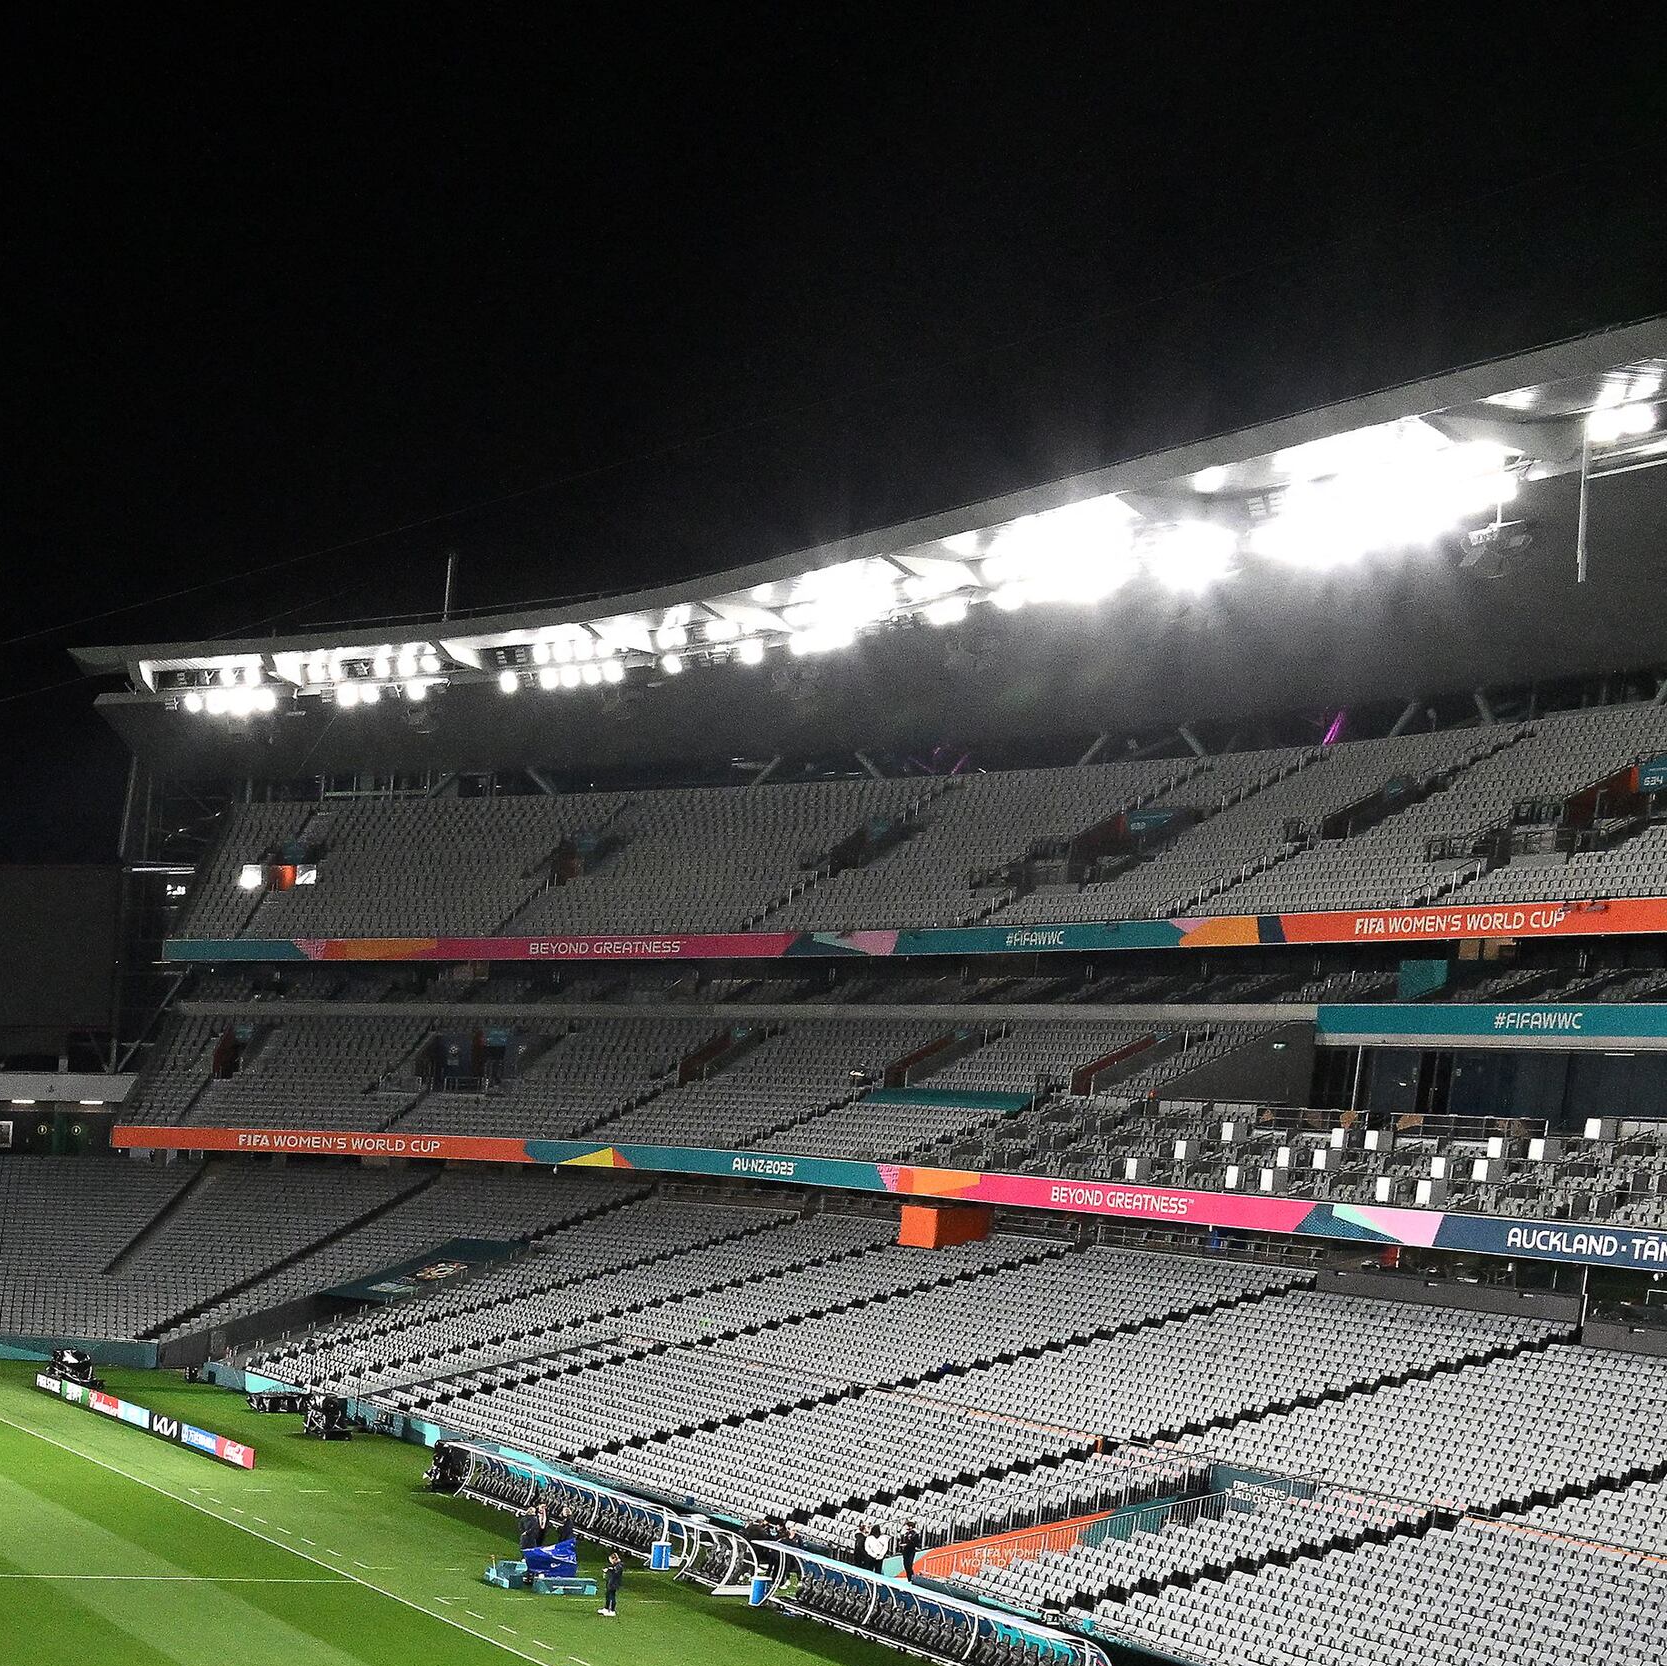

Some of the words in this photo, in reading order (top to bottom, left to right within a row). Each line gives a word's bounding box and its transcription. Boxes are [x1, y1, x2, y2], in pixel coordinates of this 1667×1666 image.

[1355, 917, 1385, 934] FIFA
[1389, 914, 1462, 933] WOMEN'S
[1467, 912, 1525, 930] WORLD
[1530, 909, 1565, 929] CUP
[1006, 930, 1065, 946] #FIFAWWC
[529, 943, 589, 955] BEYOND
[1493, 1012, 1583, 1030] #FIFAWWC
[238, 1135, 269, 1147] FIFA
[273, 1136, 347, 1149] WOMEN'S
[351, 1138, 406, 1151] WORLD
[410, 1140, 440, 1152] CUP
[1051, 1186, 1103, 1206] BEYOND
[1507, 1227, 1617, 1257] AUCKLAND
